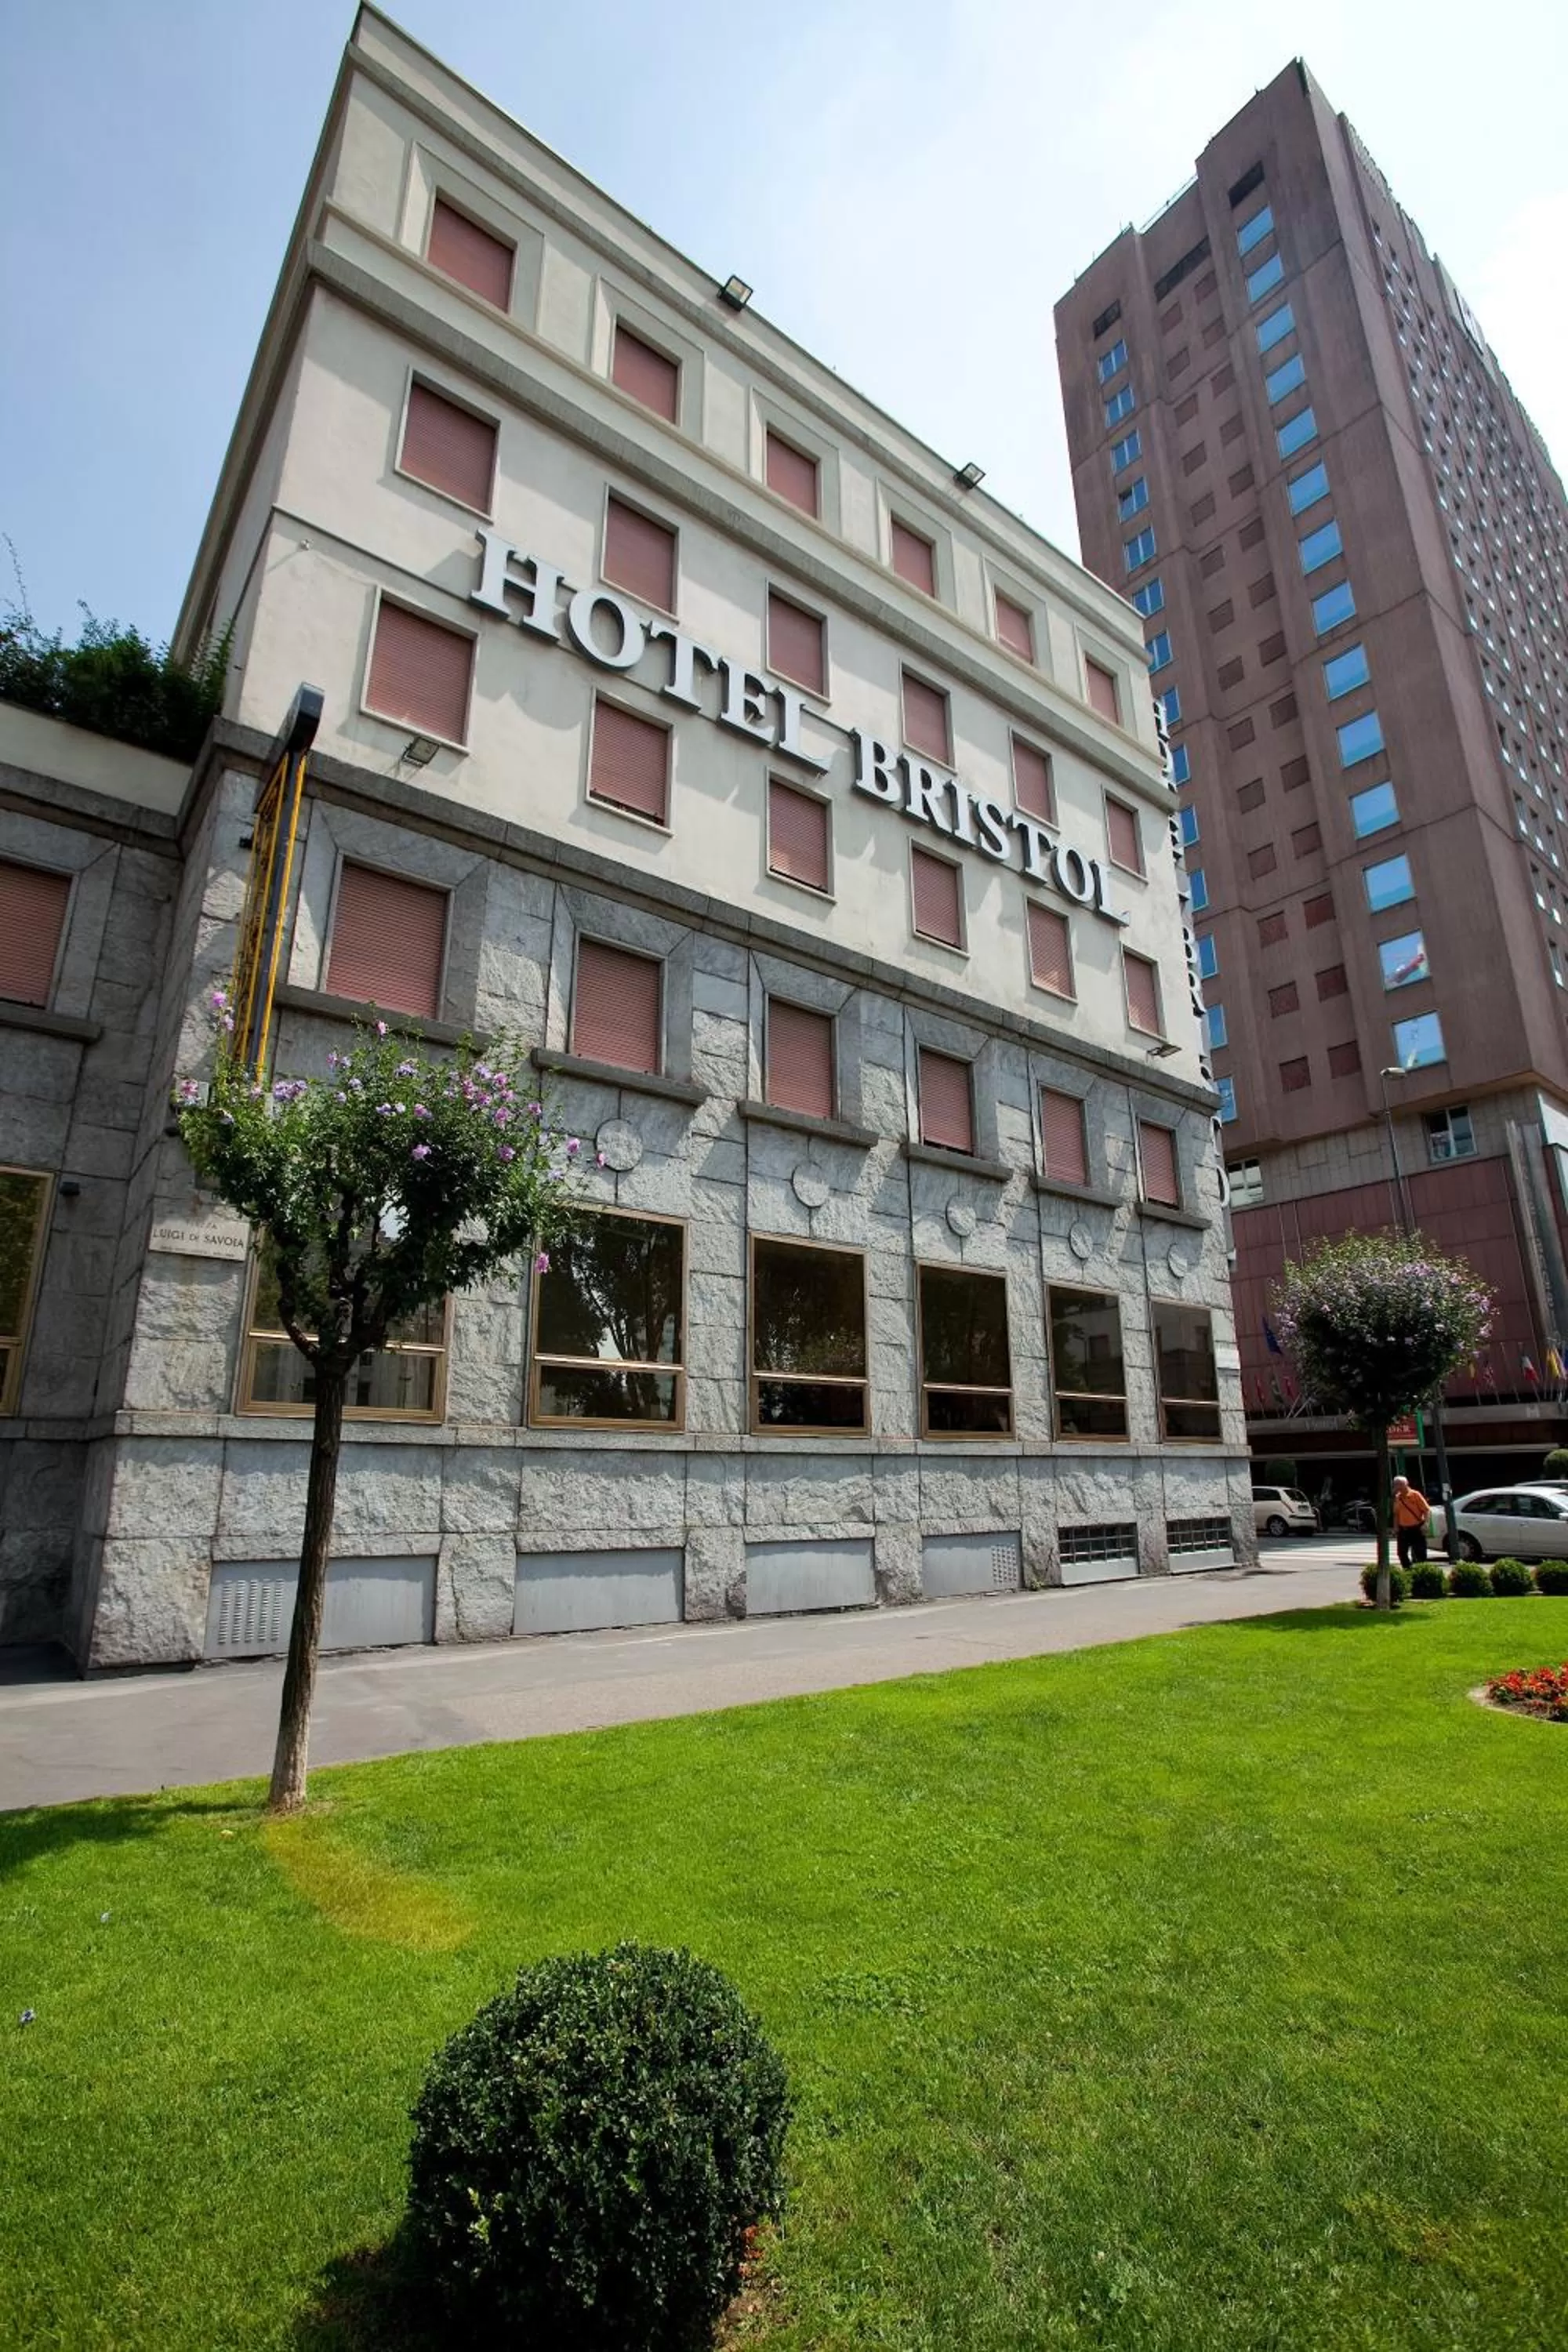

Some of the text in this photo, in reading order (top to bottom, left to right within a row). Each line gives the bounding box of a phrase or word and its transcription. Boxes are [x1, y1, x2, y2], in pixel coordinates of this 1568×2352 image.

[471, 526, 1131, 927] HOTEL BRISTOL
[152, 1229, 185, 1240] LUIGI
[204, 1234, 244, 1247] SAVOIA
